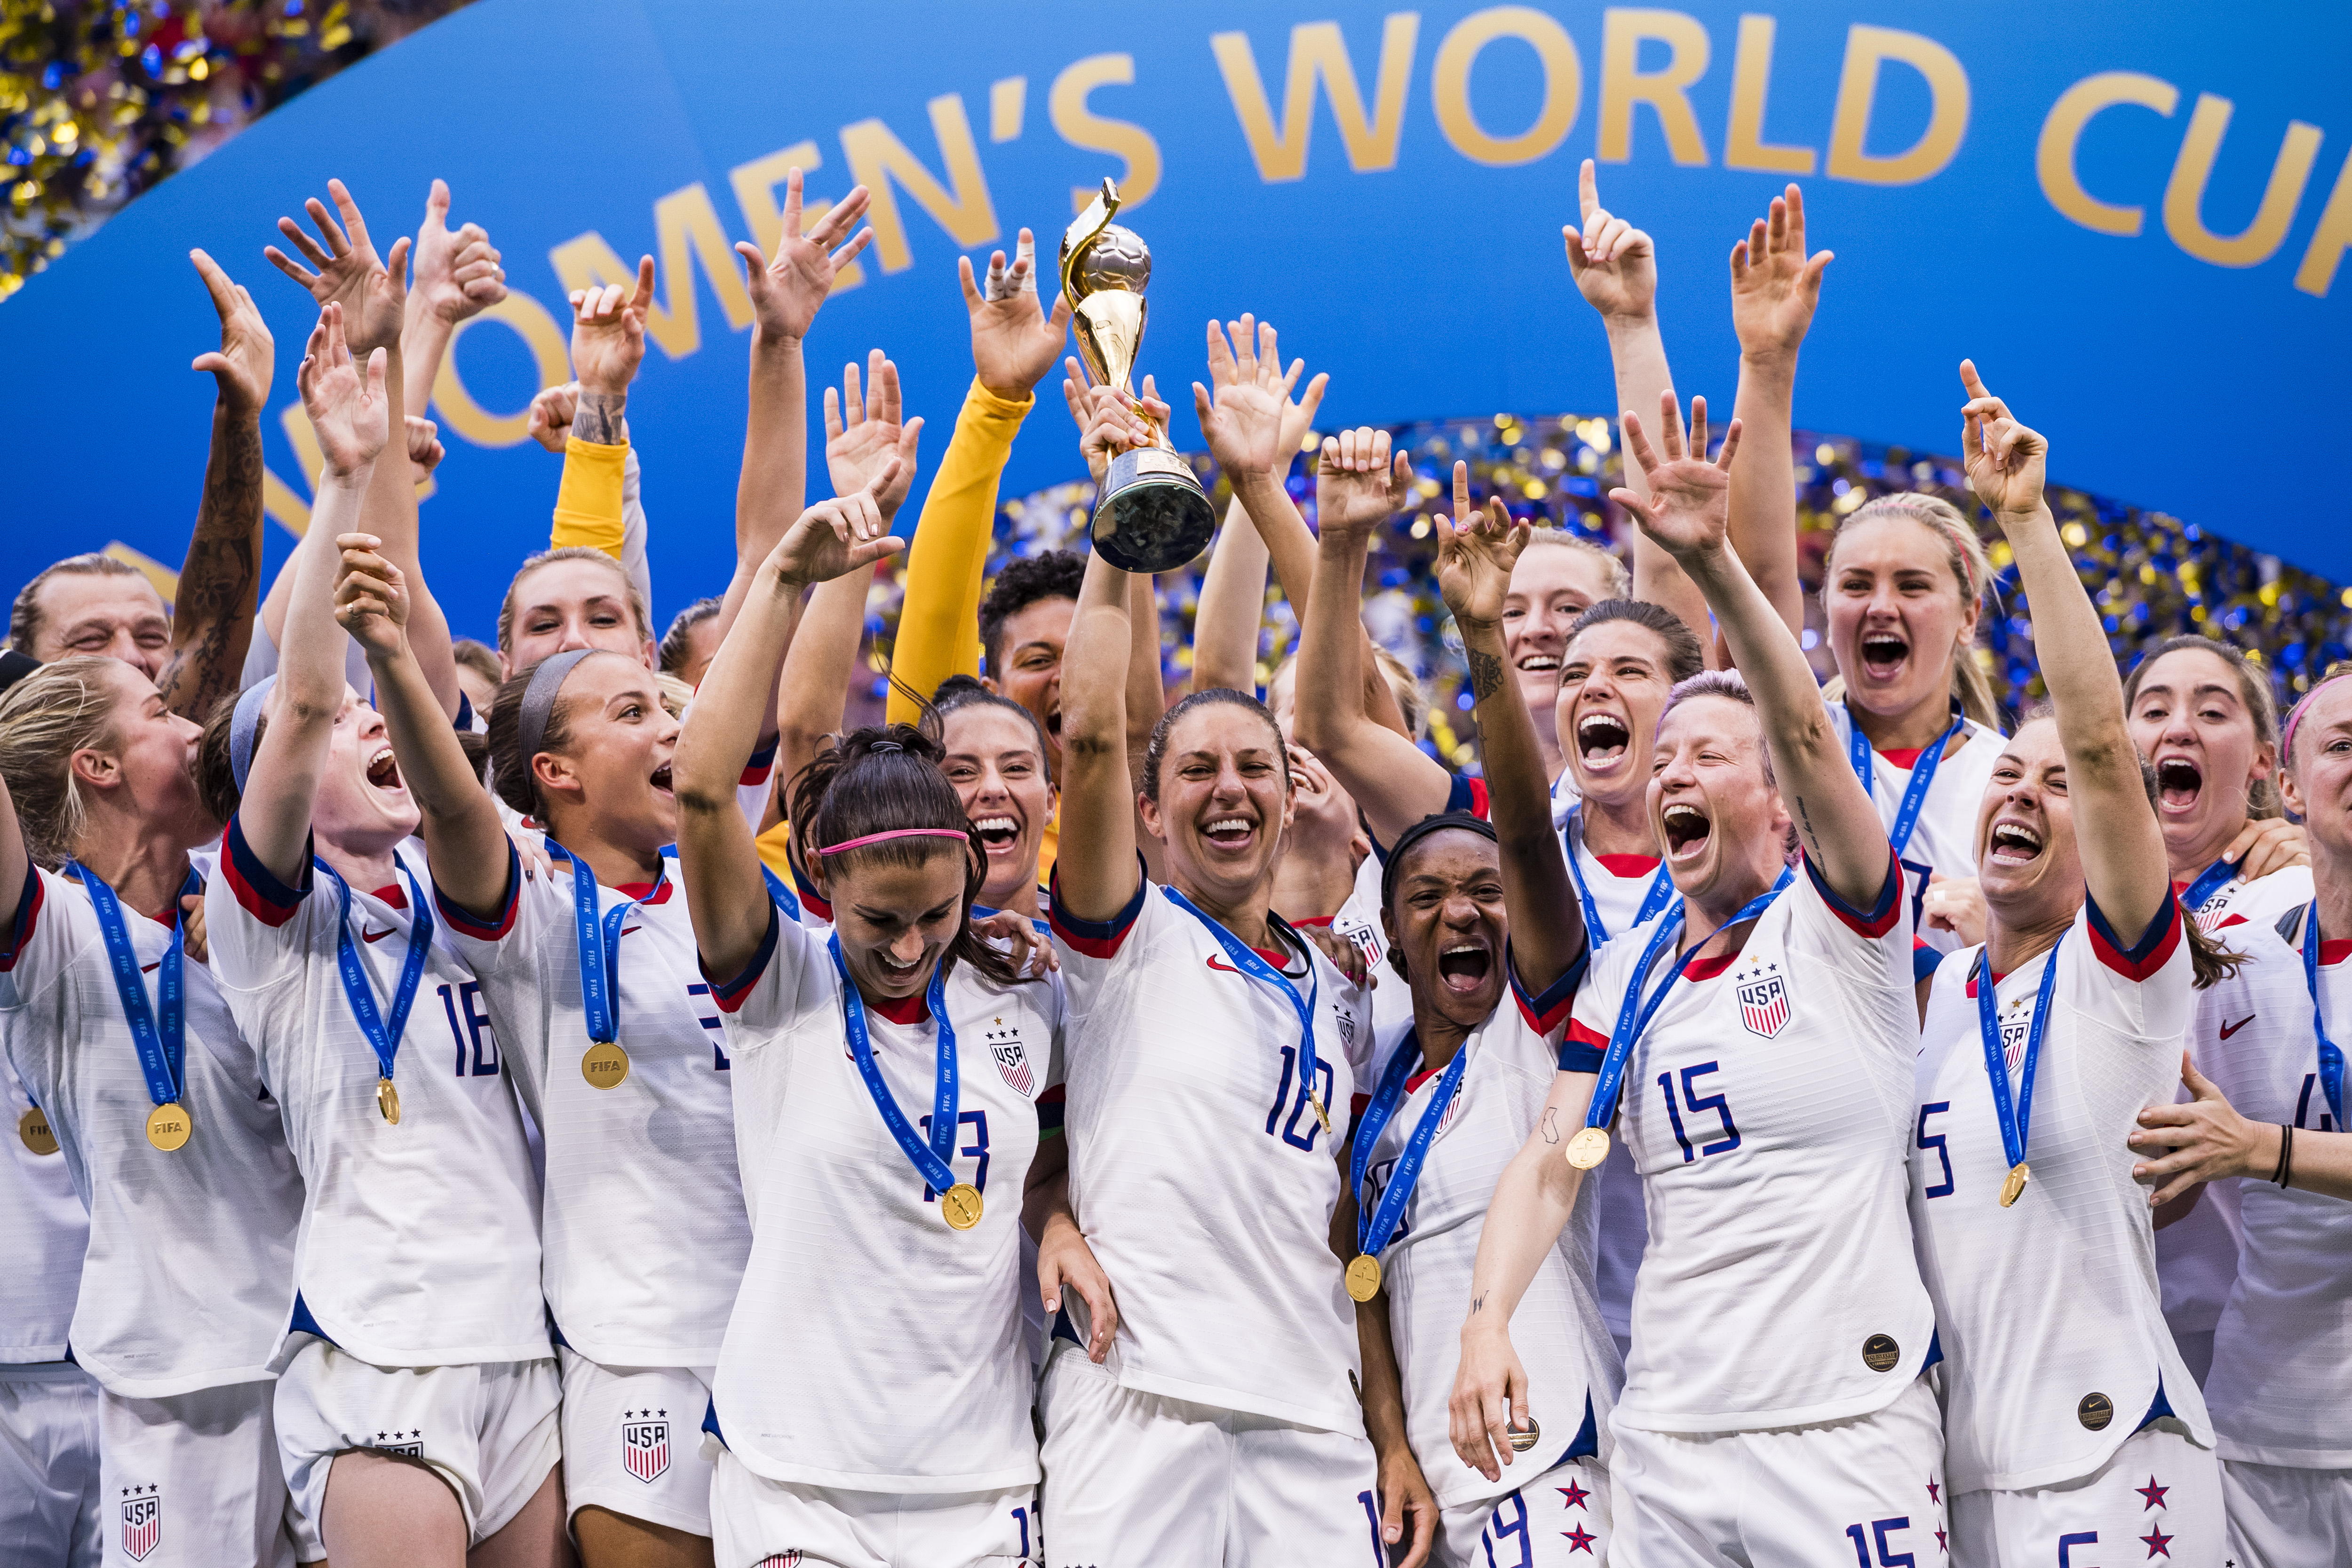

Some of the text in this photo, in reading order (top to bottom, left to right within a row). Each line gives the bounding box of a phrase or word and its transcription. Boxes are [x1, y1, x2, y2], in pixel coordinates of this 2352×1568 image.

[263, 53, 1162, 539] OMEN'S
[1212, 6, 1971, 184] WORLD
[1741, 981, 1780, 1005] USA
[2000, 1027, 2025, 1048] SA
[590, 1060, 620, 1073] FIFA
[994, 1046, 1023, 1067] USA
[1265, 1045, 1334, 1153] 10
[1657, 1060, 1741, 1163] 15
[30, 1125, 52, 1135] FIF
[154, 1121, 183, 1134] FIFA
[1917, 1100, 1955, 1199] 5
[627, 1426, 665, 1449] USA
[125, 1501, 156, 1526] USA
[1846, 1516, 1916, 1568] 15
